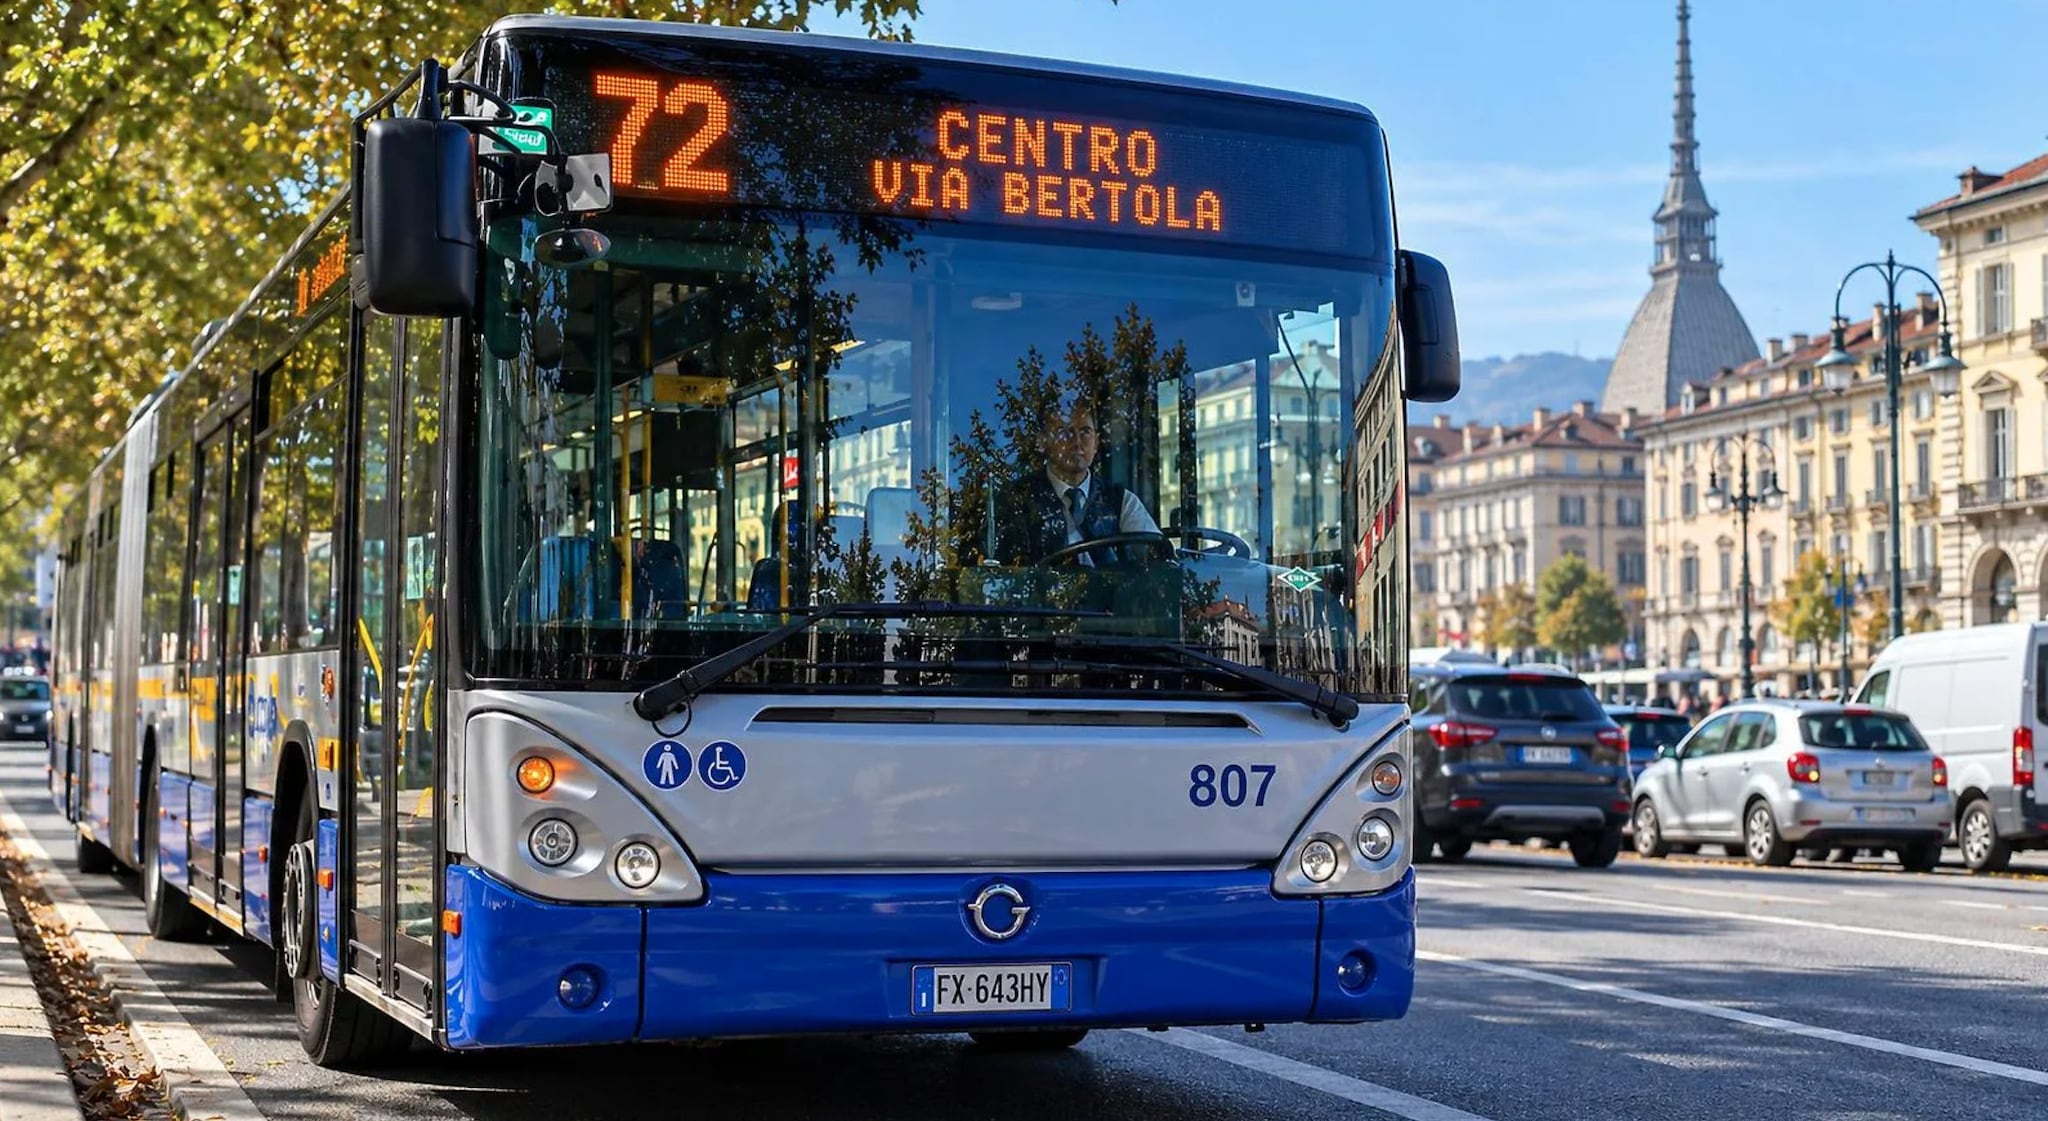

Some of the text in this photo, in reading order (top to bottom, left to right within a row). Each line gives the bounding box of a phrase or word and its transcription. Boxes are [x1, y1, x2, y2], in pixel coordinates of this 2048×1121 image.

[596, 74, 729, 193] 72
[938, 109, 1157, 179] CENTRO
[872, 158, 1222, 232] VIA BERTOLA
[1188, 763, 1277, 808] 807
